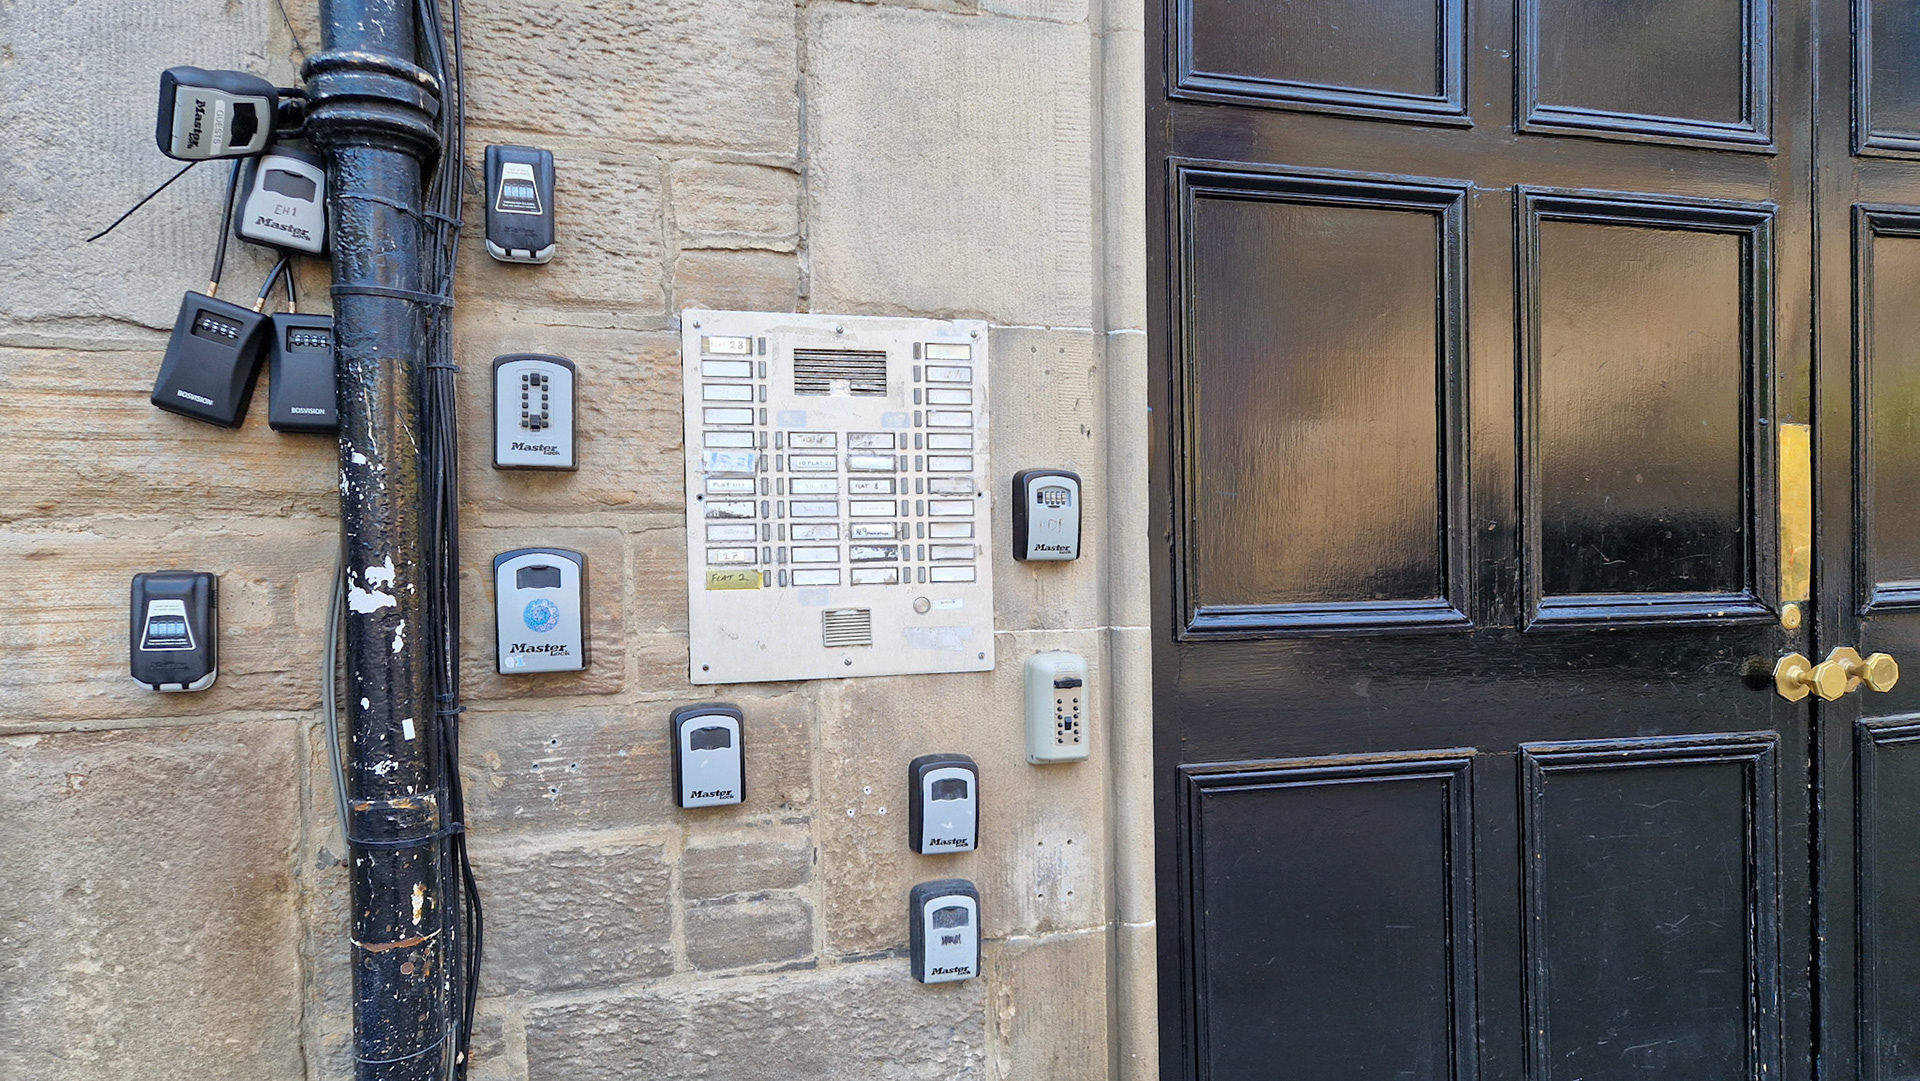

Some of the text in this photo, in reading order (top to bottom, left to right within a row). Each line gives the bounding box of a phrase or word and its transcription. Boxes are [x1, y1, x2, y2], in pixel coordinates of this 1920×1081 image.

[193, 99, 206, 147] Master
[213, 110, 224, 145] GUESTS
[274, 204, 297, 217] EH1
[255, 216, 309, 236] Master
[729, 340, 744, 350] 28
[177, 390, 214, 406] BOSVISION
[291, 406, 325, 415] BOSVISION
[511, 442, 557, 452] Master
[1034, 543, 1070, 551] Master
[722, 551, 739, 560] 17
[711, 573, 750, 583] FLAT 2
[510, 643, 567, 653] Master
[690, 789, 733, 798] Master
[929, 837, 968, 846] Master
[931, 965, 970, 975] Master
